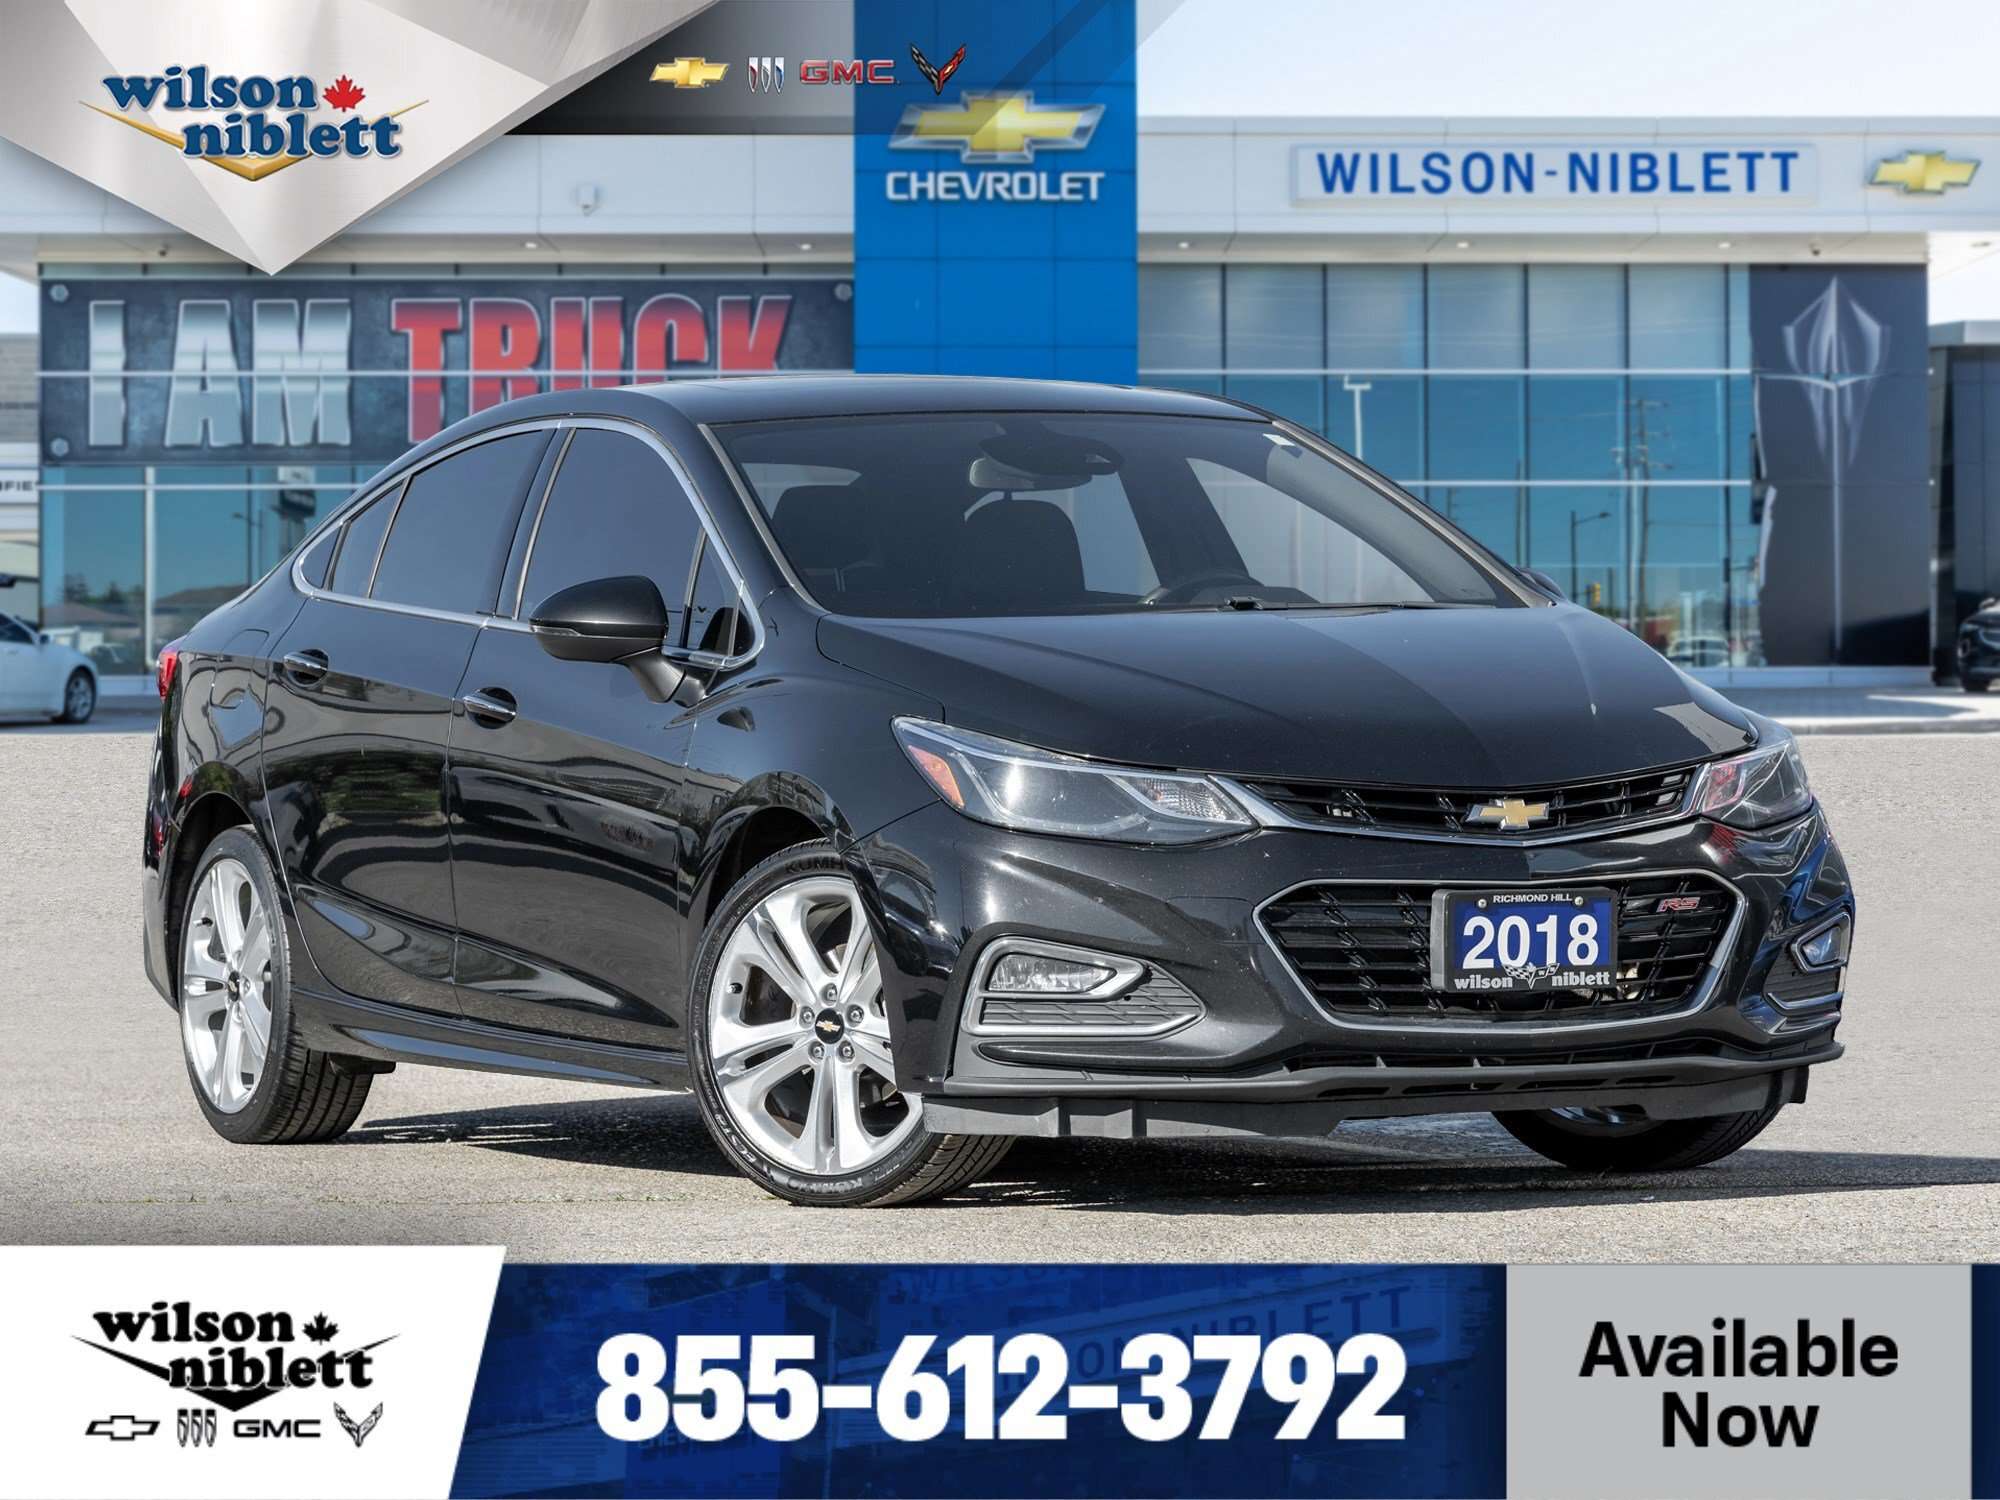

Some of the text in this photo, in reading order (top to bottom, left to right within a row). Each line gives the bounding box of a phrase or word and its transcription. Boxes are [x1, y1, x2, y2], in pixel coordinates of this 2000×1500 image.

[886, 171, 1105, 201] CHEVROLET
[1317, 151, 1799, 195] WILSON-NIBLETT
[88, 294, 792, 448] I AM TRUCK
[1493, 893, 1573, 903] RICHMOND HILL
[1656, 896, 1700, 912] RS
[1462, 914, 1599, 969] 2018
[1454, 974, 1513, 989] wilson
[1551, 969, 1610, 987] niblett
